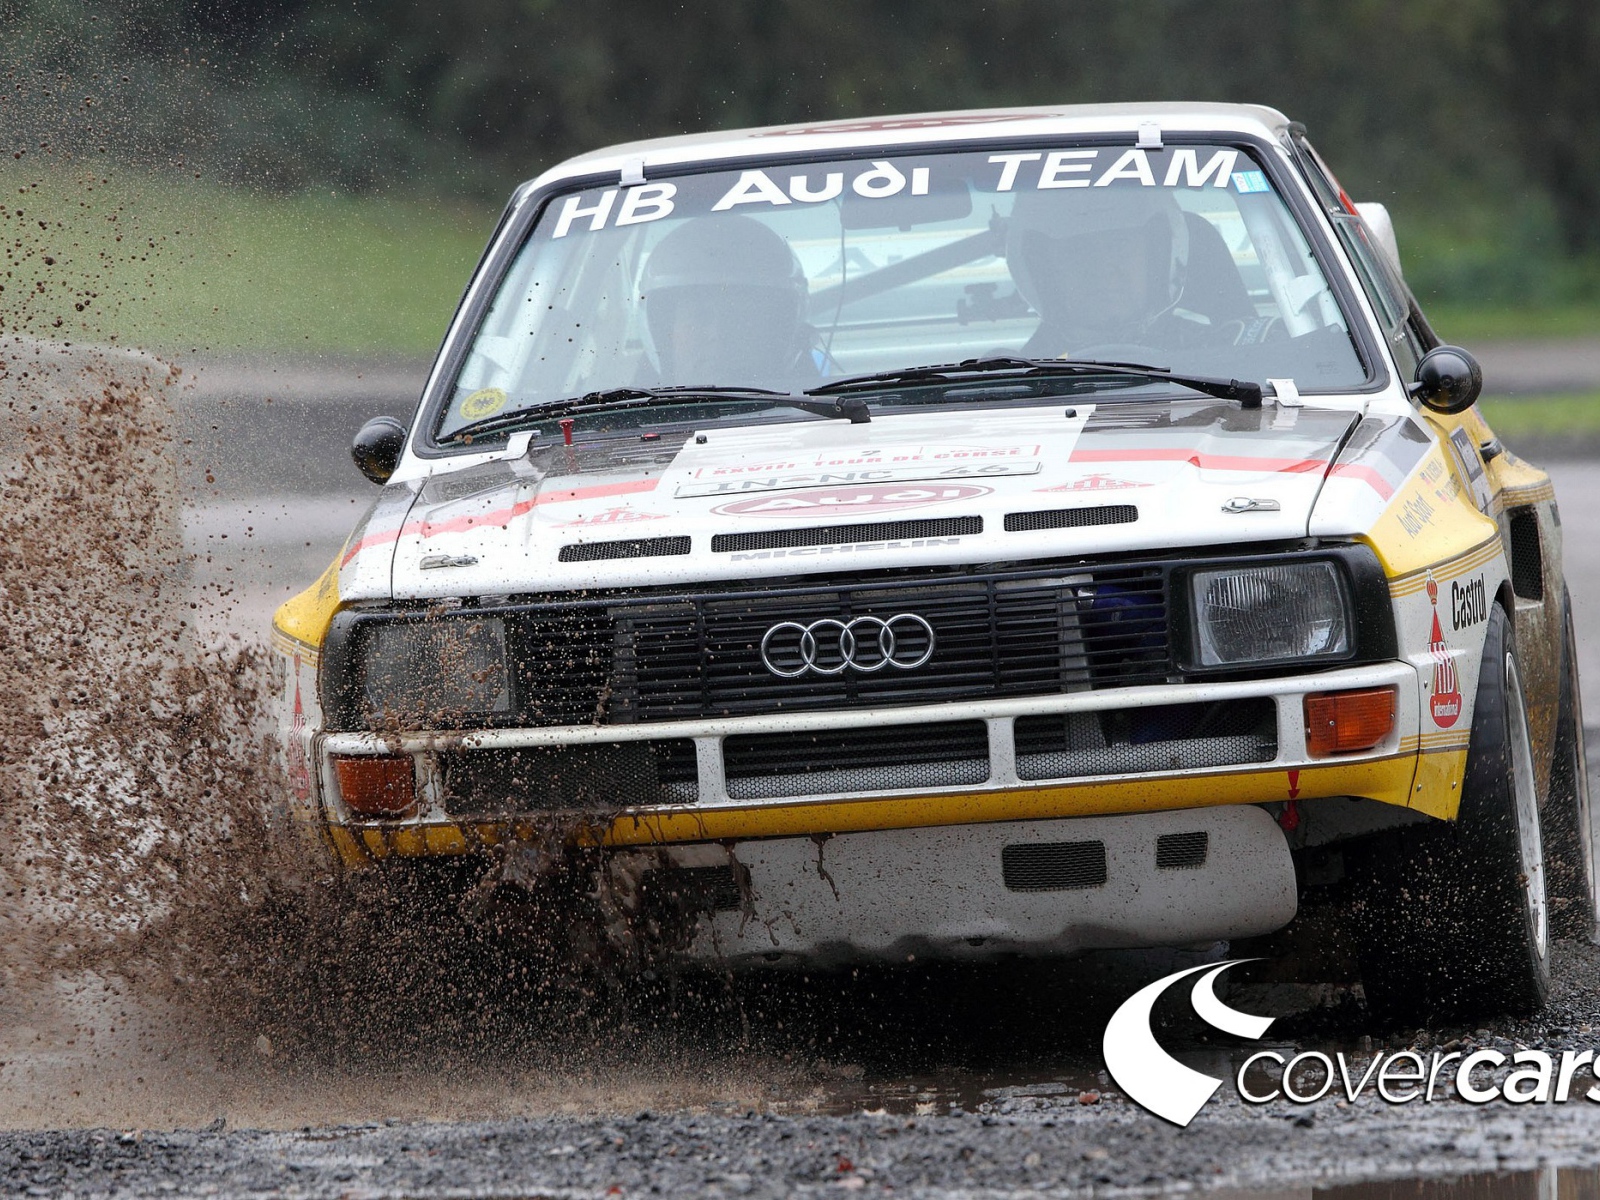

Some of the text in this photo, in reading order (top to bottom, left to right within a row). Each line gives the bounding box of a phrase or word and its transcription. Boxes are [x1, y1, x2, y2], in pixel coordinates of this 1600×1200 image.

[552, 182, 678, 239] HB
[988, 149, 1238, 192] TEAM
[813, 457, 883, 467] TOUR
[892, 454, 924, 462] DE
[933, 448, 1022, 460] CORSE
[939, 464, 1009, 475] 46
[730, 537, 961, 562] MICHELIN
[1451, 572, 1487, 631] Castrol
